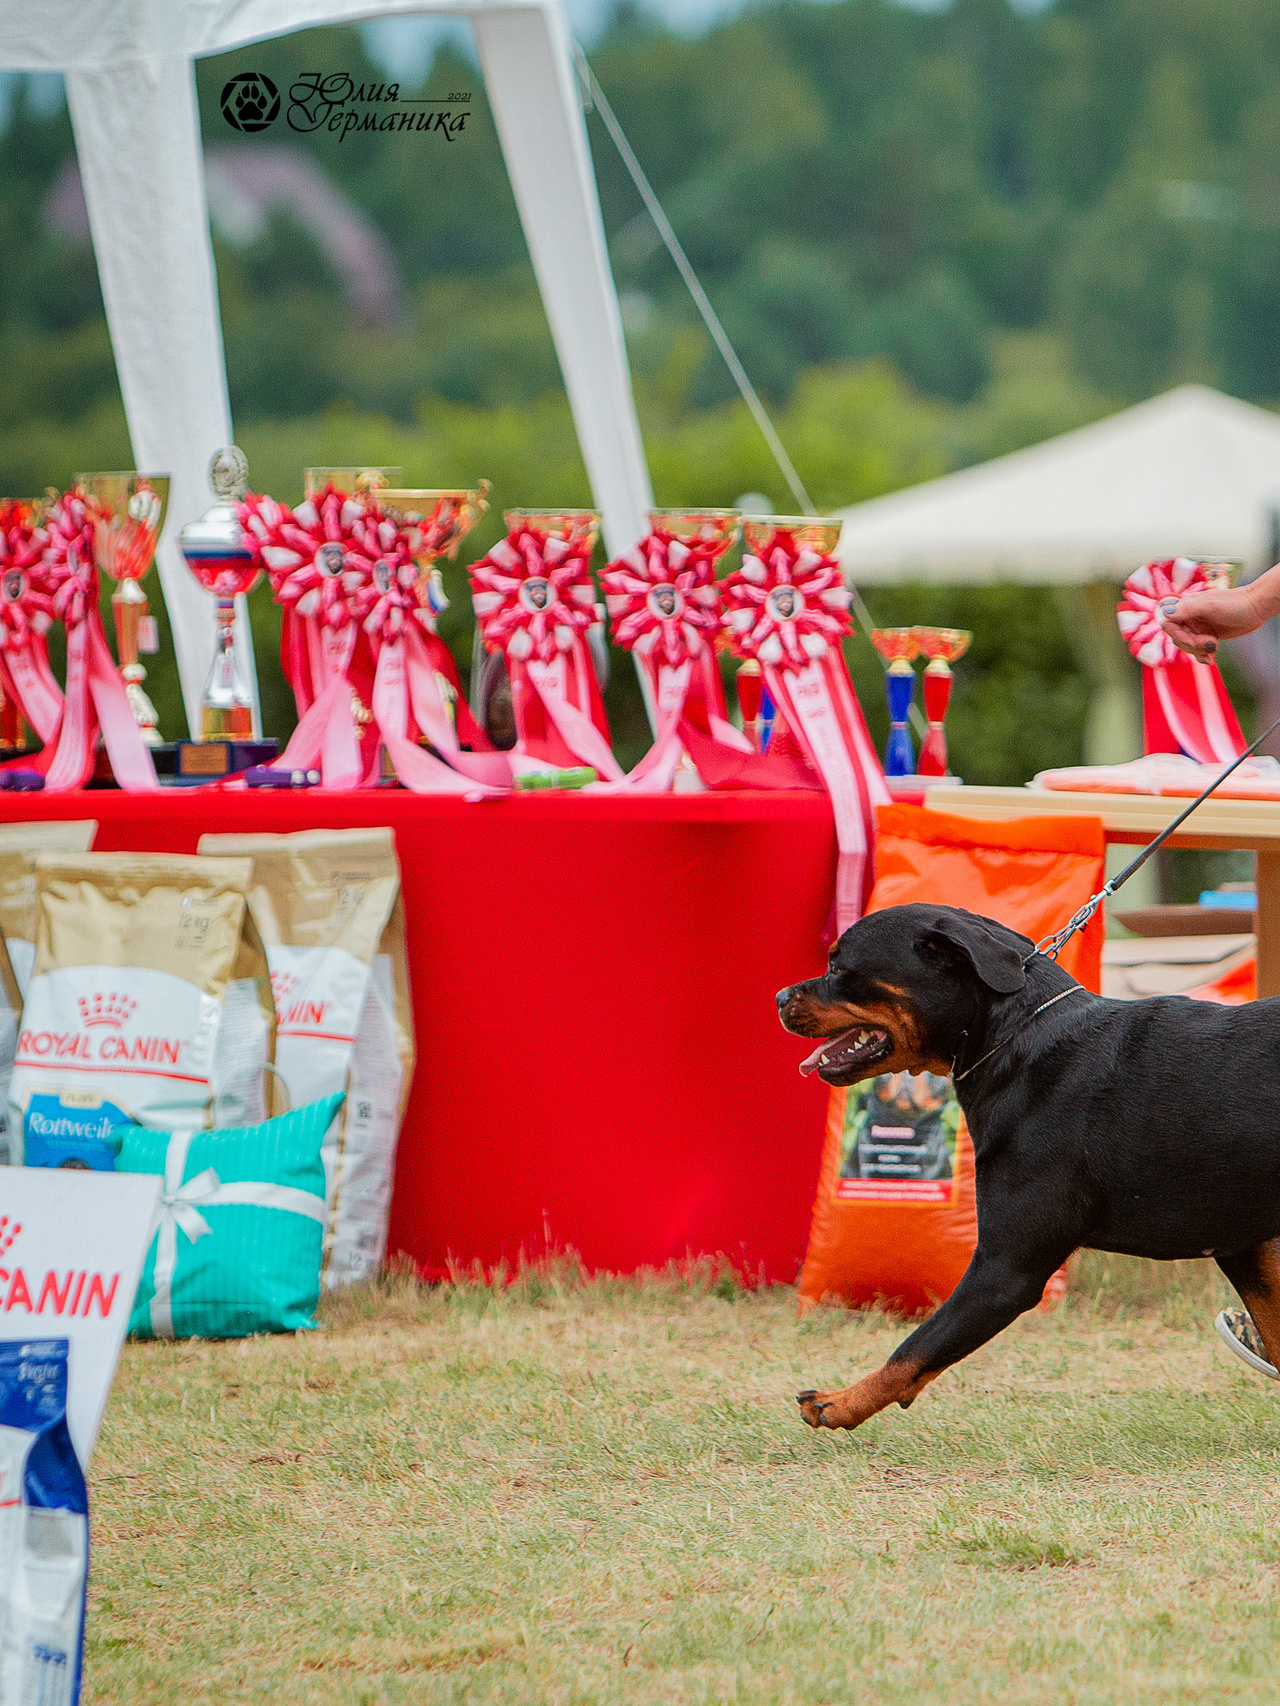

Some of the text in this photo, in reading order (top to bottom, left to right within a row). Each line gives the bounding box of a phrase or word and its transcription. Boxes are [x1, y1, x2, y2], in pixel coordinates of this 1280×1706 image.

[16, 1030, 182, 1065] ROYAL CANIN
[0, 1268, 121, 1319] ANIN
